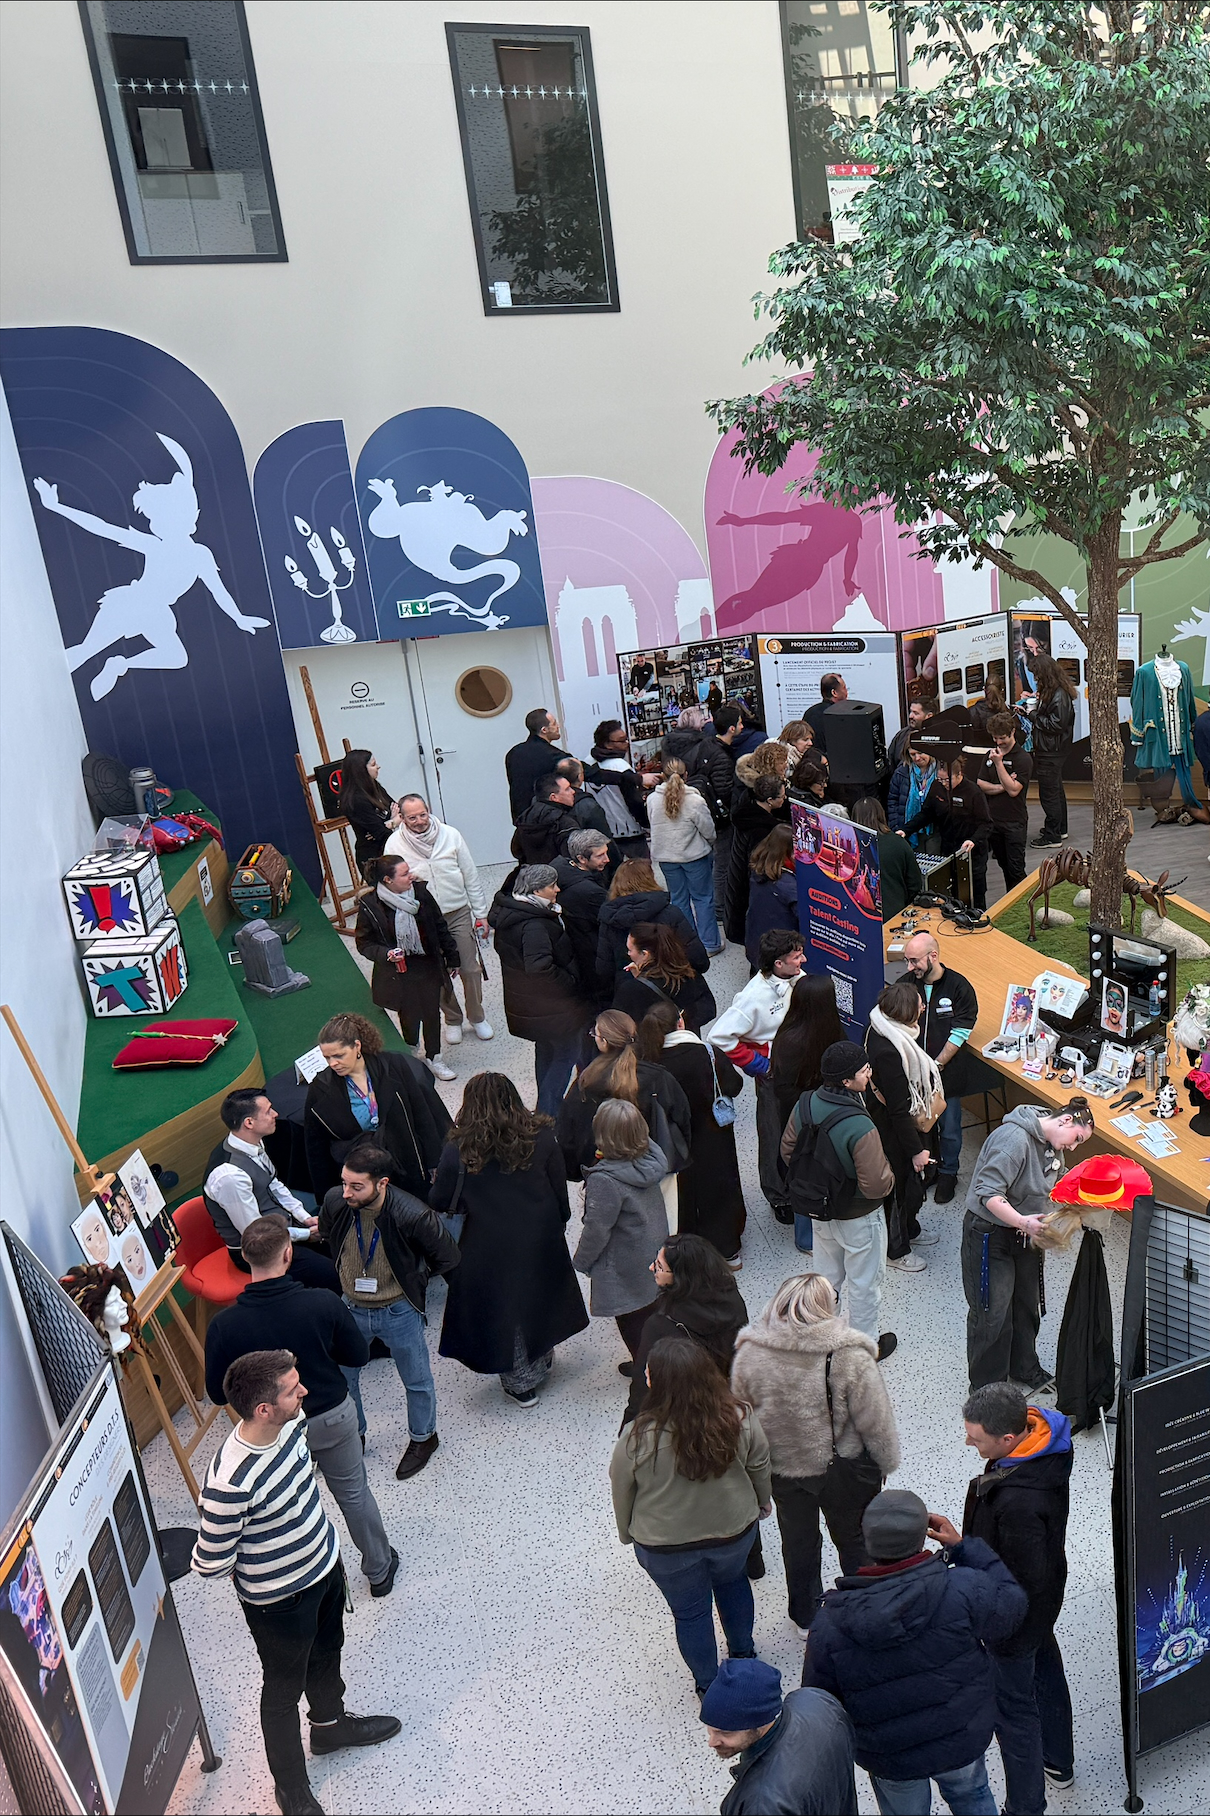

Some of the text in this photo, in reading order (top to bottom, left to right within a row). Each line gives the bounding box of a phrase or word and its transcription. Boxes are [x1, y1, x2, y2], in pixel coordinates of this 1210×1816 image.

[972, 631, 1004, 642] ACCESSOIRISTE
[809, 905, 832, 921] Talent
[833, 916, 859, 936] Casting
[95, 966, 147, 1012] T
[160, 945, 181, 1001] W
[70, 1408, 119, 1506] CONCEPTEURS D.T.S
